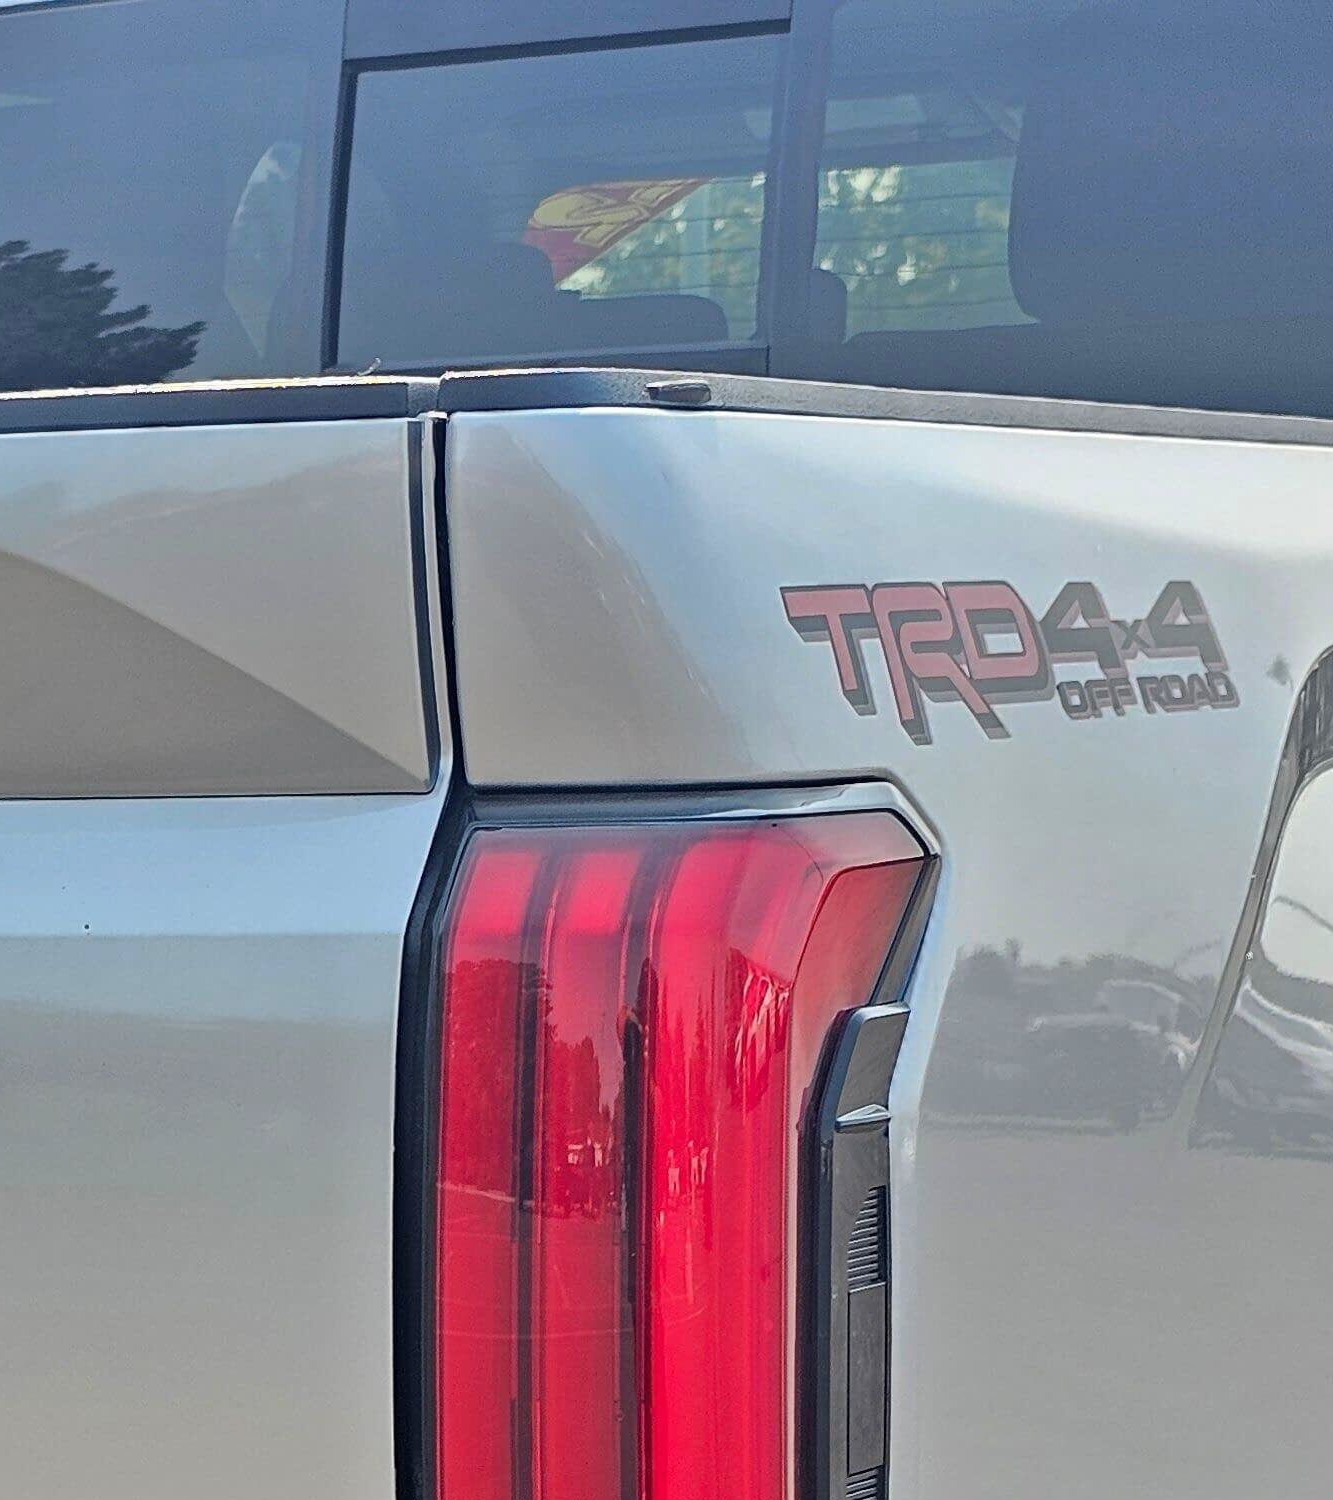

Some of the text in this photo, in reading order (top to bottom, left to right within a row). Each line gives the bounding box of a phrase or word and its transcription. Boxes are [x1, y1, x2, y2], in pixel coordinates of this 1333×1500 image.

[780, 580, 1055, 746] TRD
[1057, 671, 1240, 719] OFF ROAD
